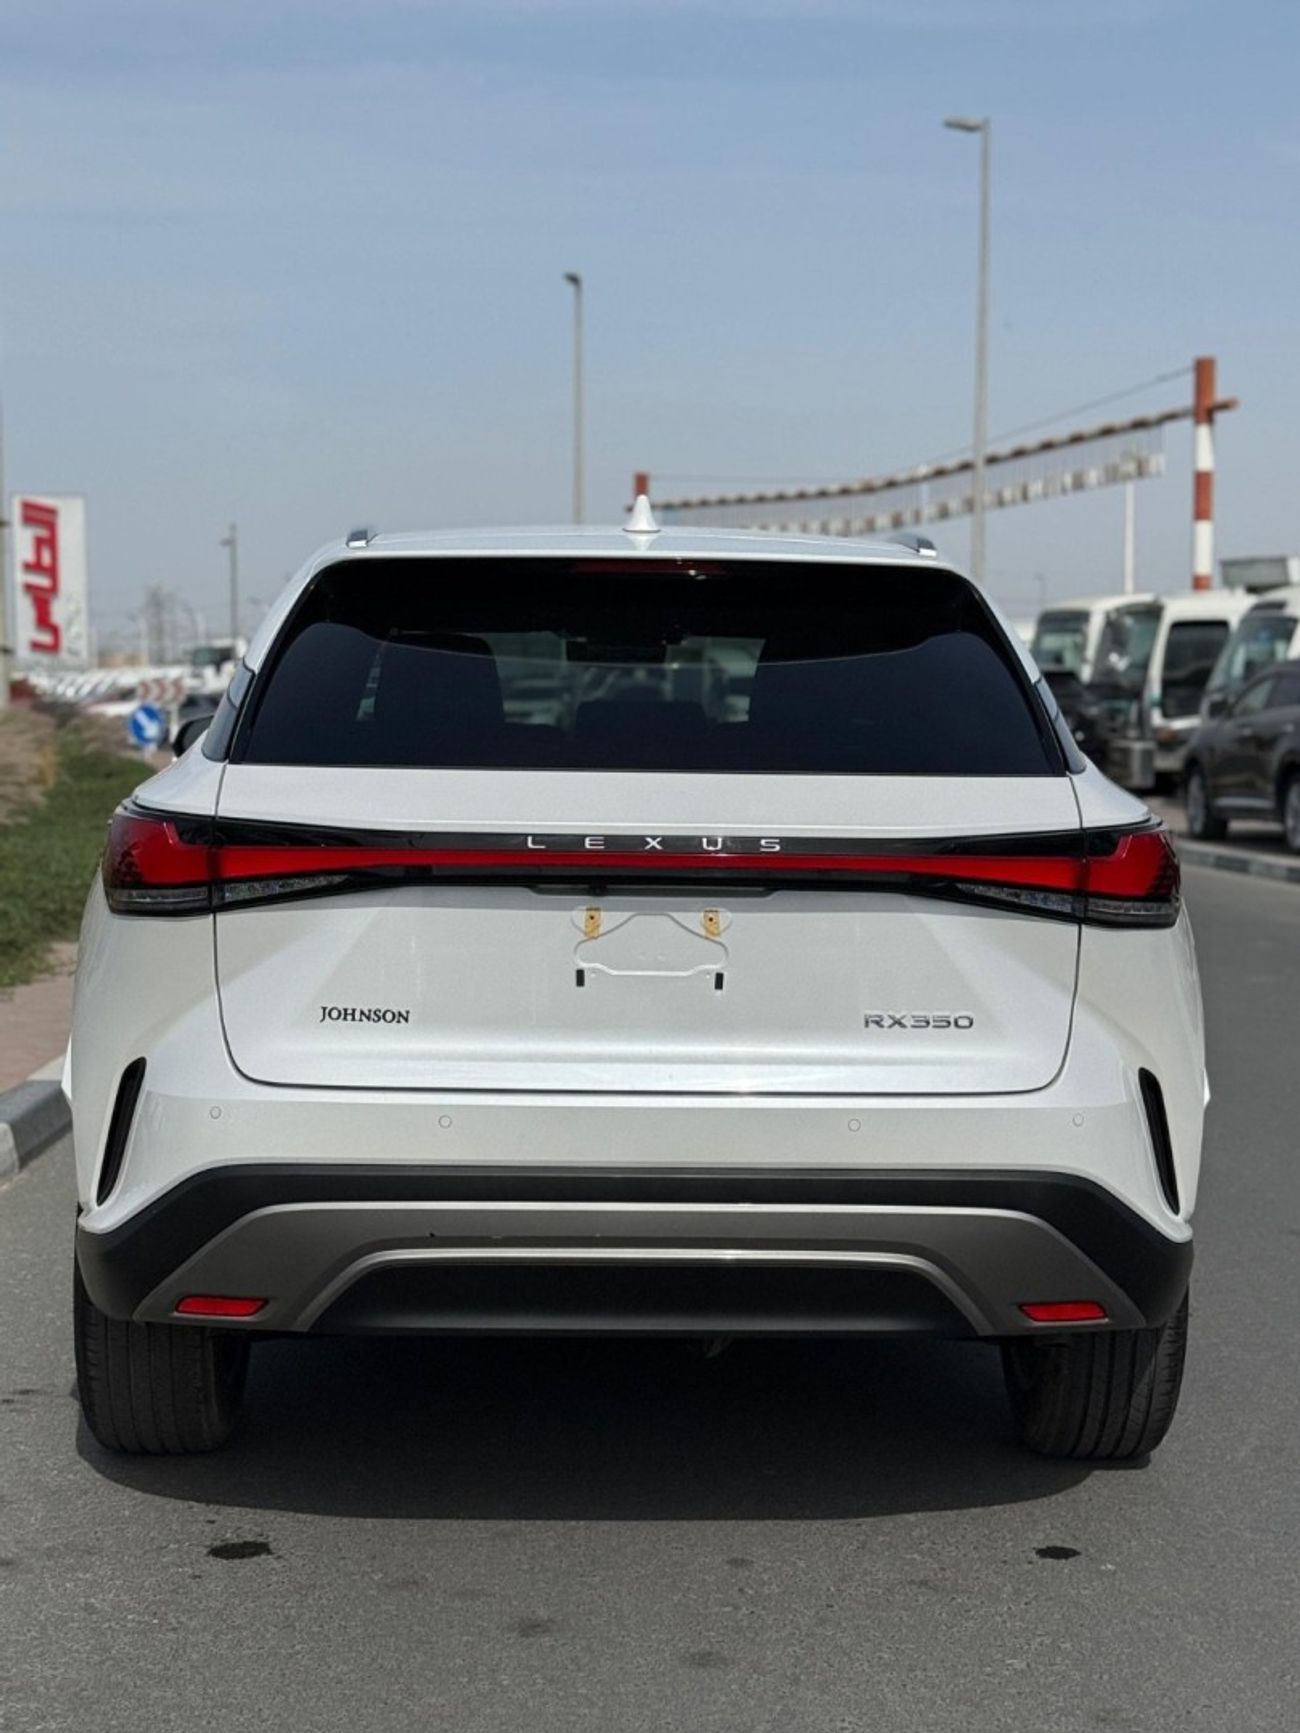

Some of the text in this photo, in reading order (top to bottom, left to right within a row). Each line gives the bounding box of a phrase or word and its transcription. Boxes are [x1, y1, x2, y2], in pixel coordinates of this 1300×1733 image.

[526, 835, 781, 852] LEXUS
[320, 1006, 410, 1024] JOHNSON
[864, 1013, 974, 1029] RX350
